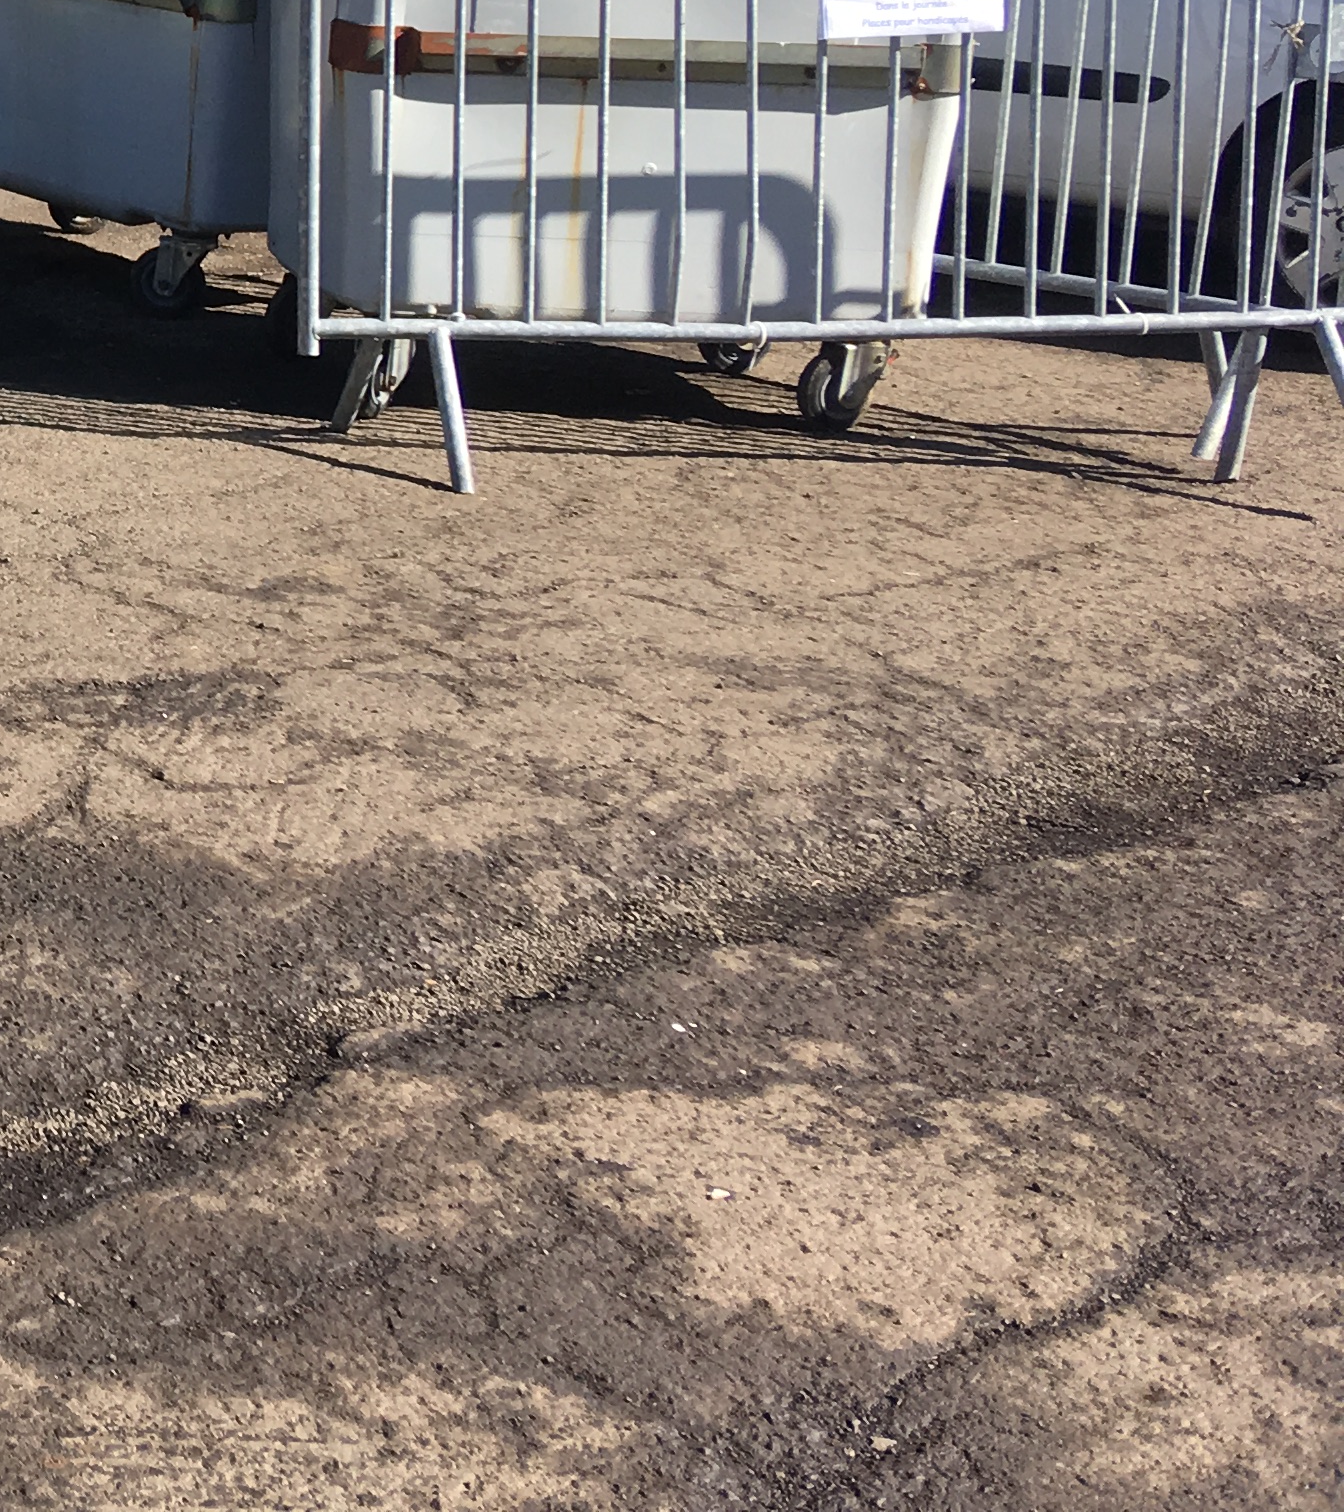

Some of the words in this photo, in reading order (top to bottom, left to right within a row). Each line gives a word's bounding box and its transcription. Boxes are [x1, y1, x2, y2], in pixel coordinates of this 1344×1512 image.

[875, 1, 899, 11] Dans
[861, 18, 891, 28] Places
[893, 18, 915, 29] pour
